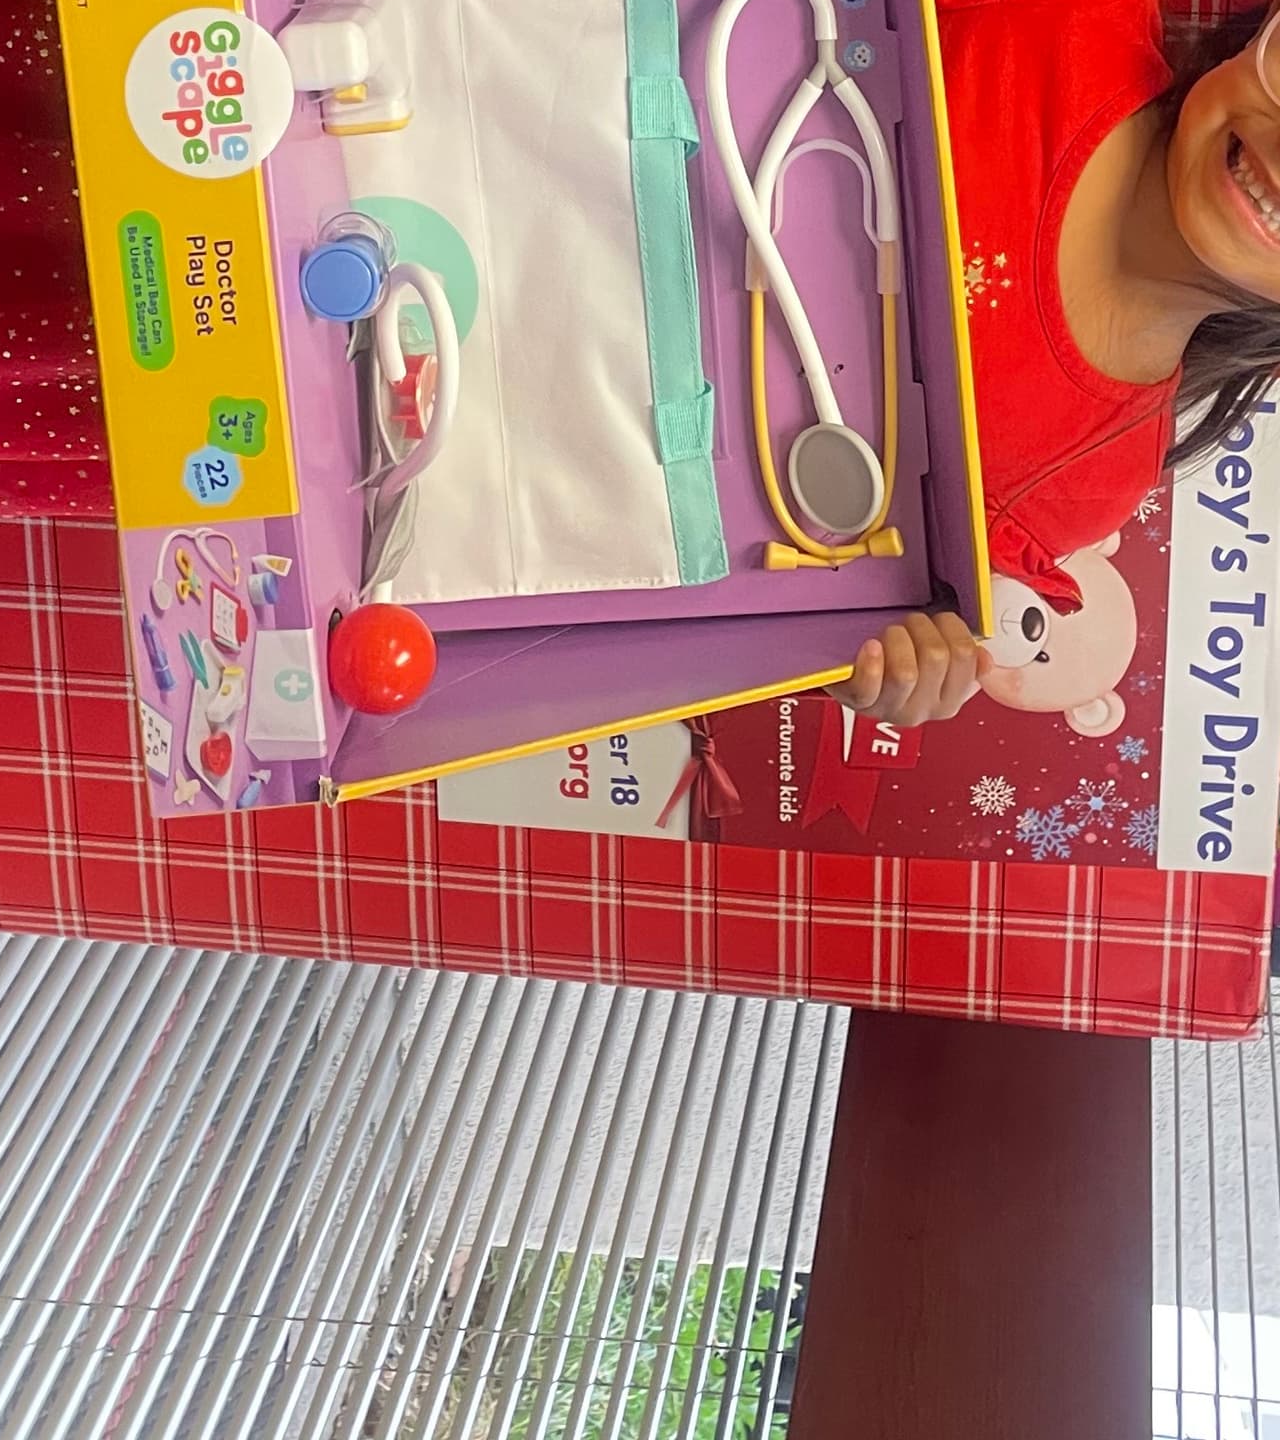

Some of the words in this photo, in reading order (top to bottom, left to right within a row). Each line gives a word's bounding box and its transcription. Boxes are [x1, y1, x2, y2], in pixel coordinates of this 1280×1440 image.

[127, 226, 138, 243] Be
[129, 247, 143, 280] Used
[142, 236, 157, 287] Medical
[185, 235, 208, 287] Play
[133, 284, 143, 298] as
[213, 240, 238, 326] Doctor
[147, 291, 159, 316] Bag
[192, 296, 215, 336] Set
[135, 300, 152, 356] Storage!
[151, 319, 163, 345] Can
[218, 413, 238, 441] 3+
[243, 411, 256, 444] Ages
[192, 462, 208, 499] Pieces
[204, 460, 229, 491] 22
[1189, 592, 1267, 698] Toy
[778, 698, 798, 781] fortunate
[609, 774, 640, 806] 18
[778, 785, 798, 823] kids
[1196, 714, 1259, 863] Drive
